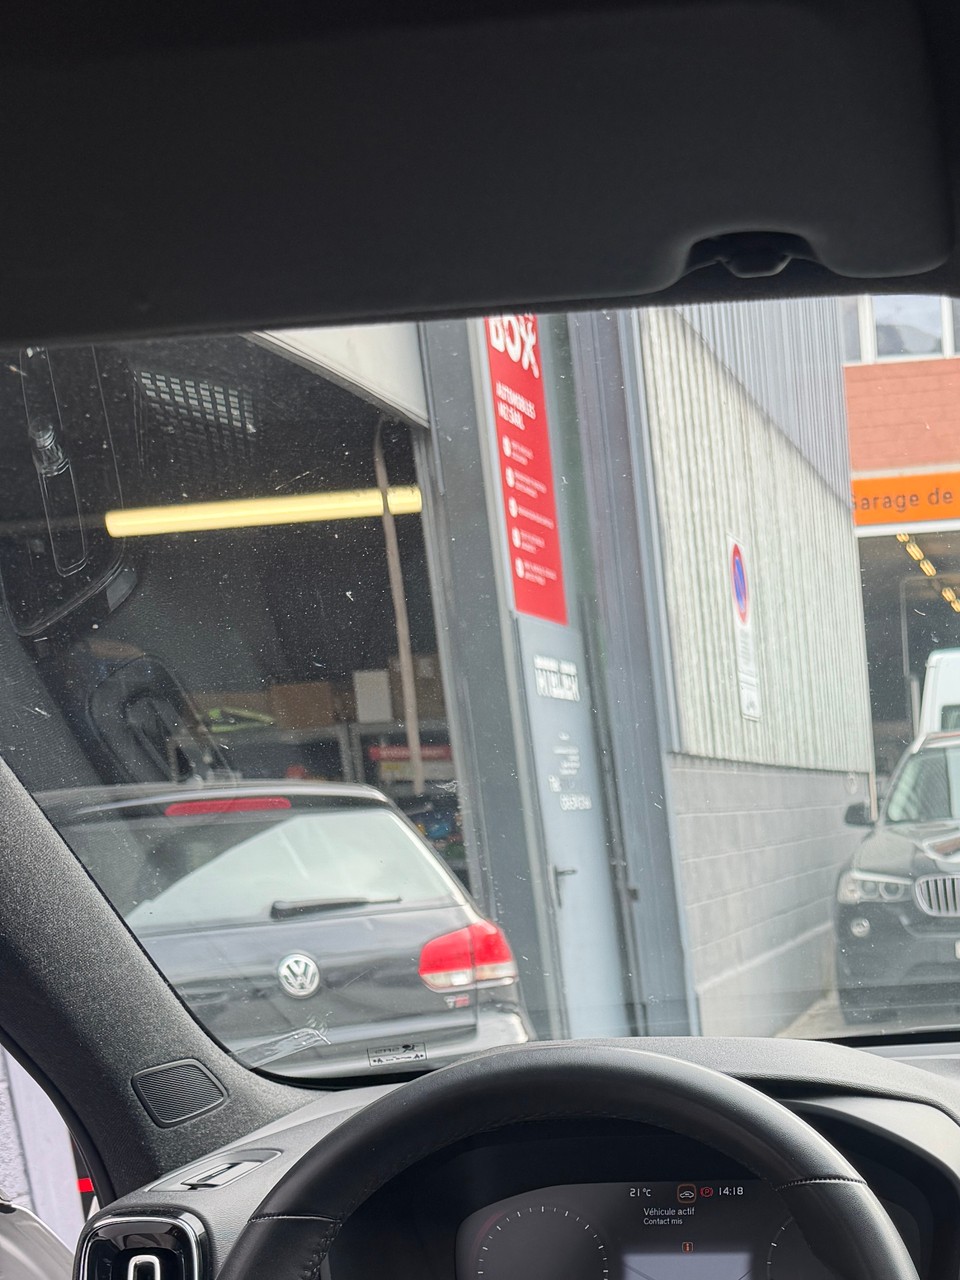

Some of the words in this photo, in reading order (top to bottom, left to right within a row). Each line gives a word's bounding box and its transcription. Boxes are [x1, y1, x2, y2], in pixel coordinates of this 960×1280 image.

[927, 488, 953, 505] de
[719, 1186, 744, 1196] 14:18
[643, 1207, 676, 1216] Véhicule
[677, 1206, 695, 1216] actif
